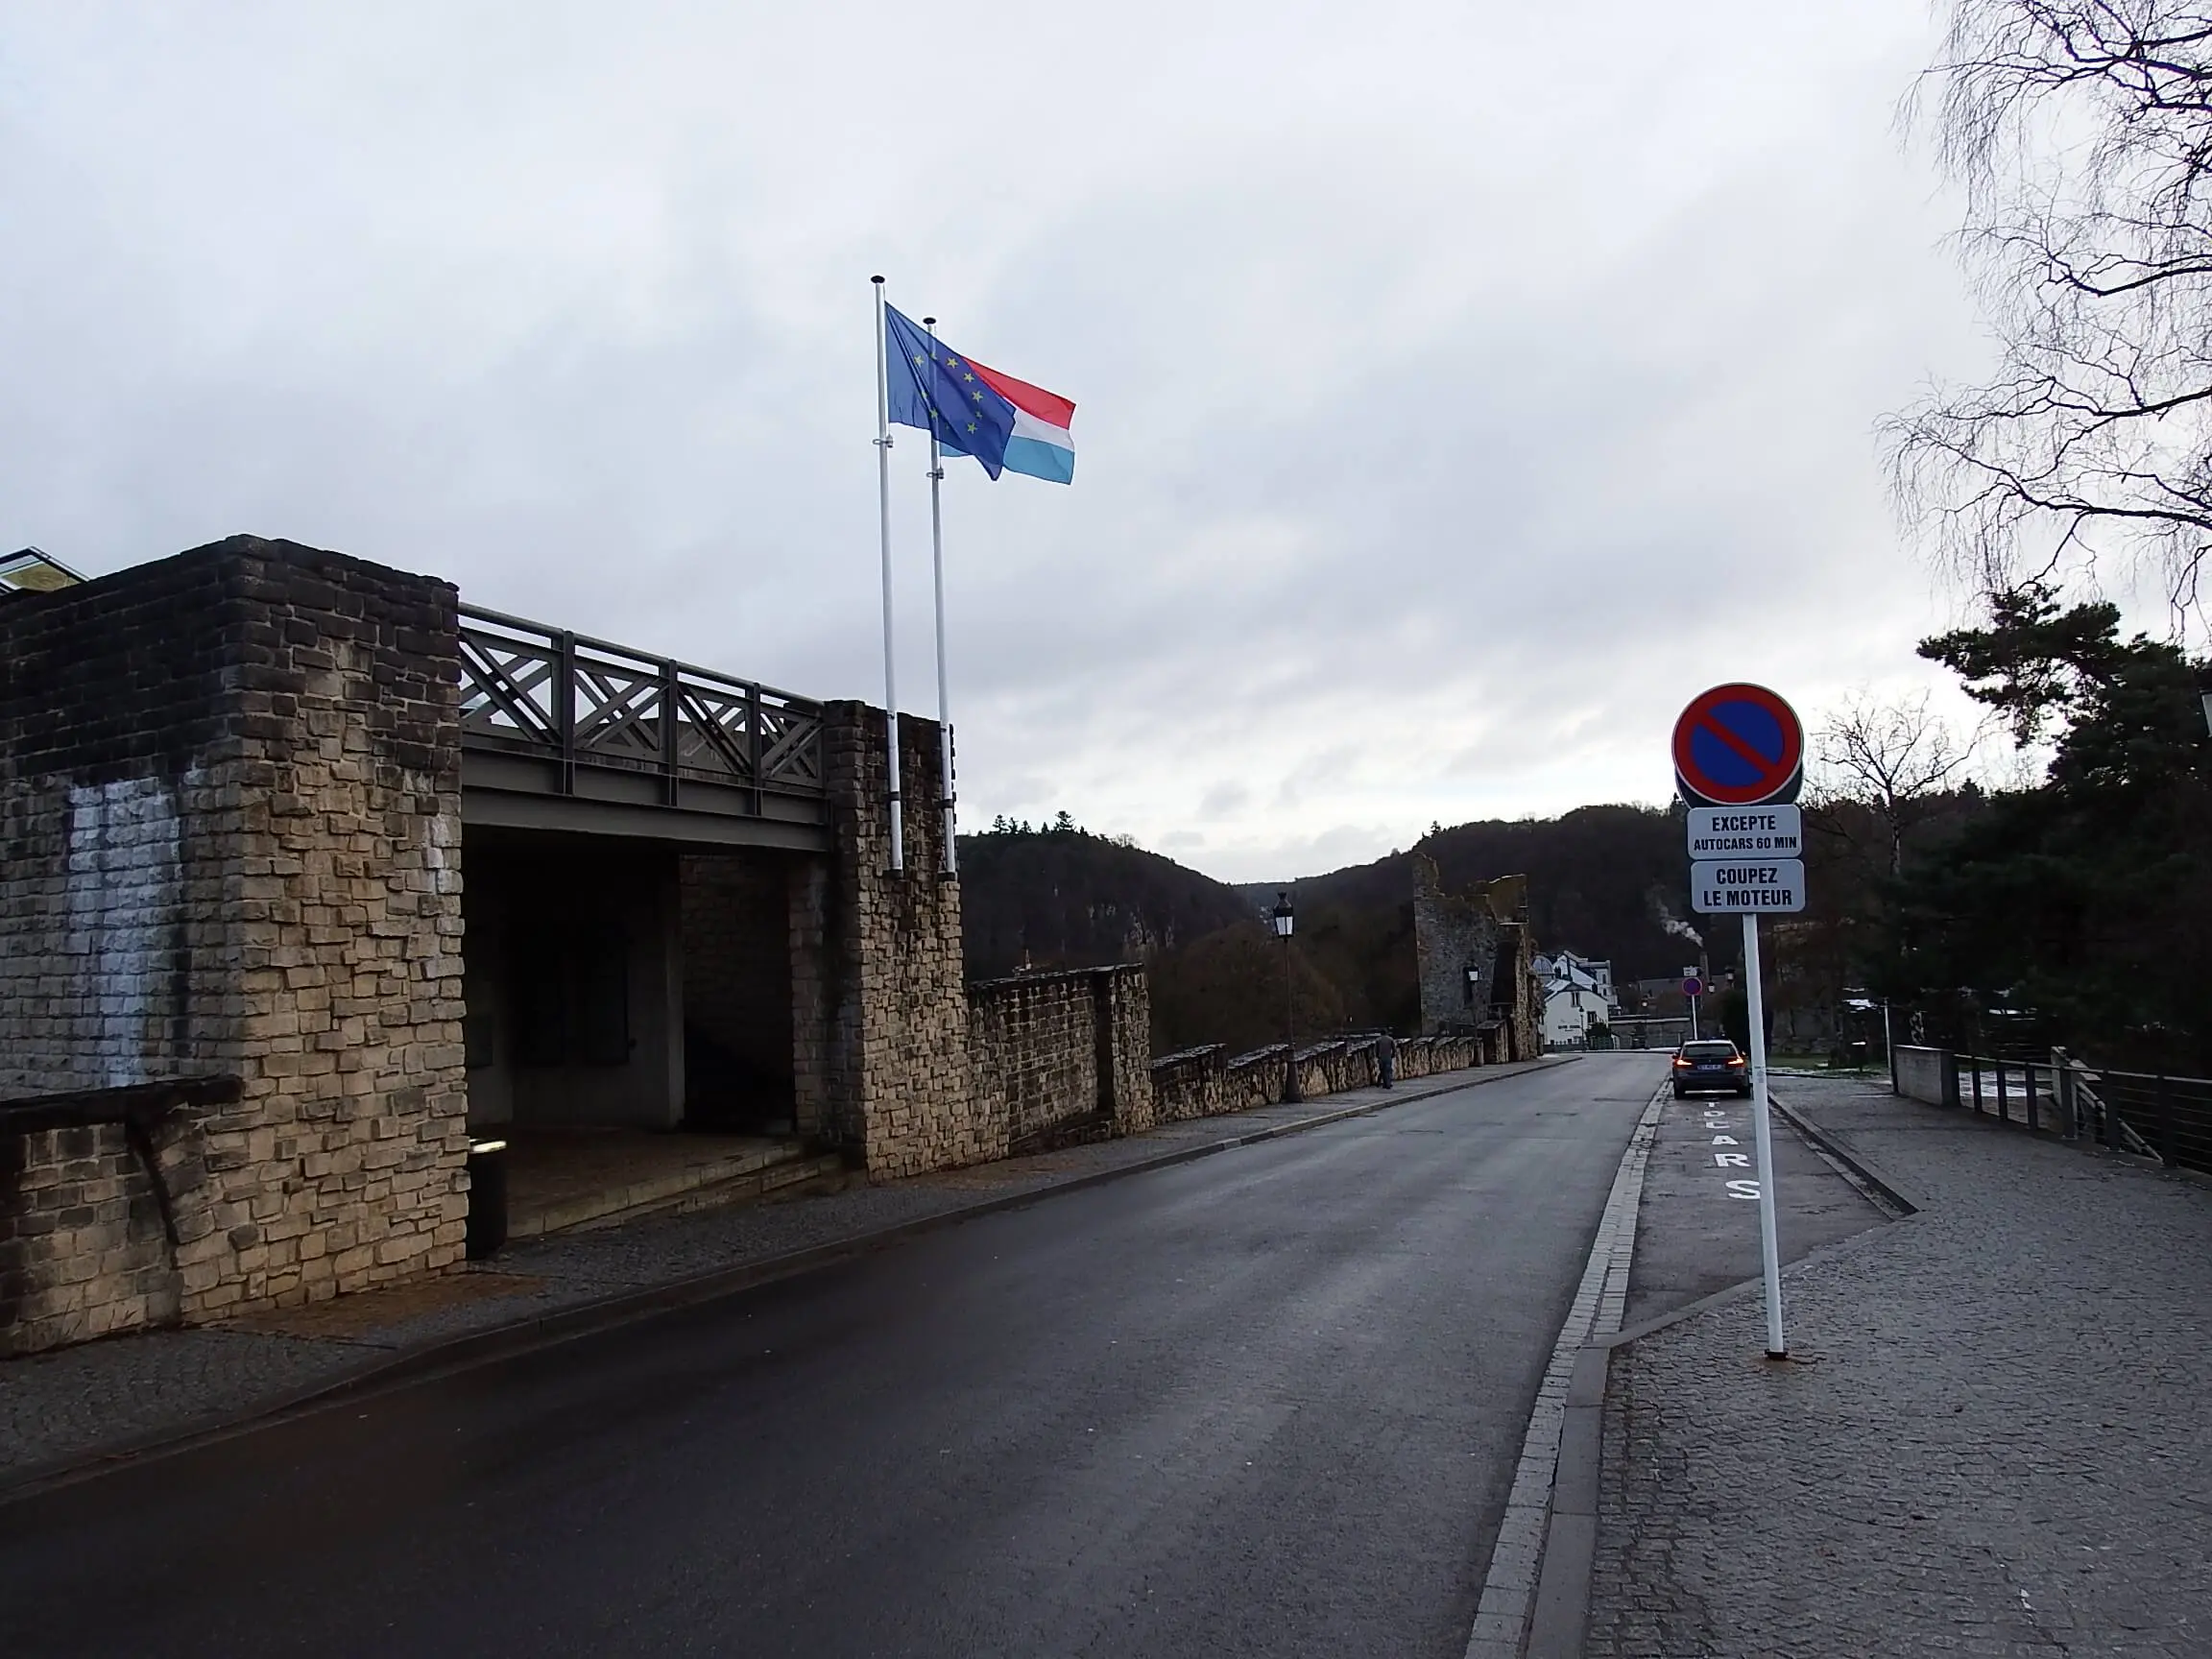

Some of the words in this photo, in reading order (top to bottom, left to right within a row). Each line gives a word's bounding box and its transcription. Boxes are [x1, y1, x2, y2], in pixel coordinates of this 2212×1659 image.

[1712, 815, 1776, 831] EXCEPTE
[1694, 837, 1753, 851] AUTOCARS
[1756, 837, 1771, 849] 60
[1774, 836, 1797, 849] MIN
[1716, 867, 1778, 884] COUPEZ
[1703, 890, 1722, 906] LE
[1726, 889, 1792, 906] MOTEUR
